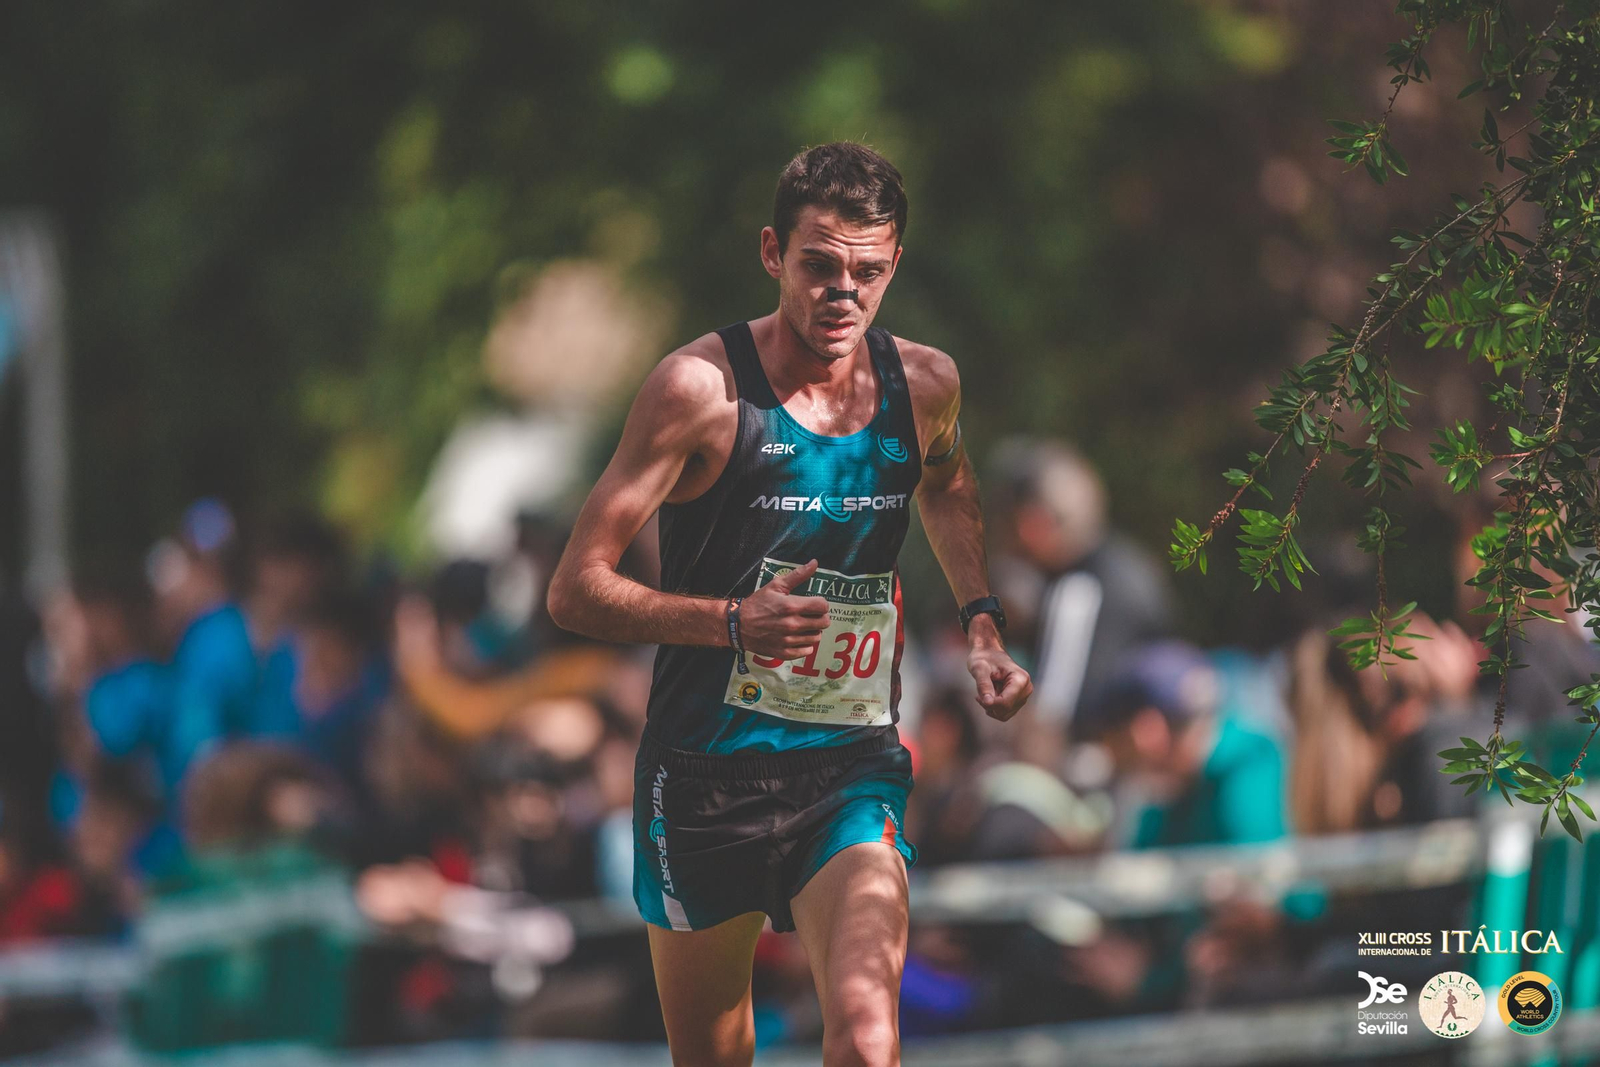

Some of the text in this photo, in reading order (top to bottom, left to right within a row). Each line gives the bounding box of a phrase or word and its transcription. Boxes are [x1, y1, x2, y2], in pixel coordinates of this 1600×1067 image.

[761, 443, 797, 455] 42K
[749, 491, 907, 521] METAESPORT
[807, 576, 870, 600] ITÁLICA
[828, 608, 861, 617] ANVALERO
[828, 615, 857, 623] ETAESPORT
[752, 630, 881, 679] 130
